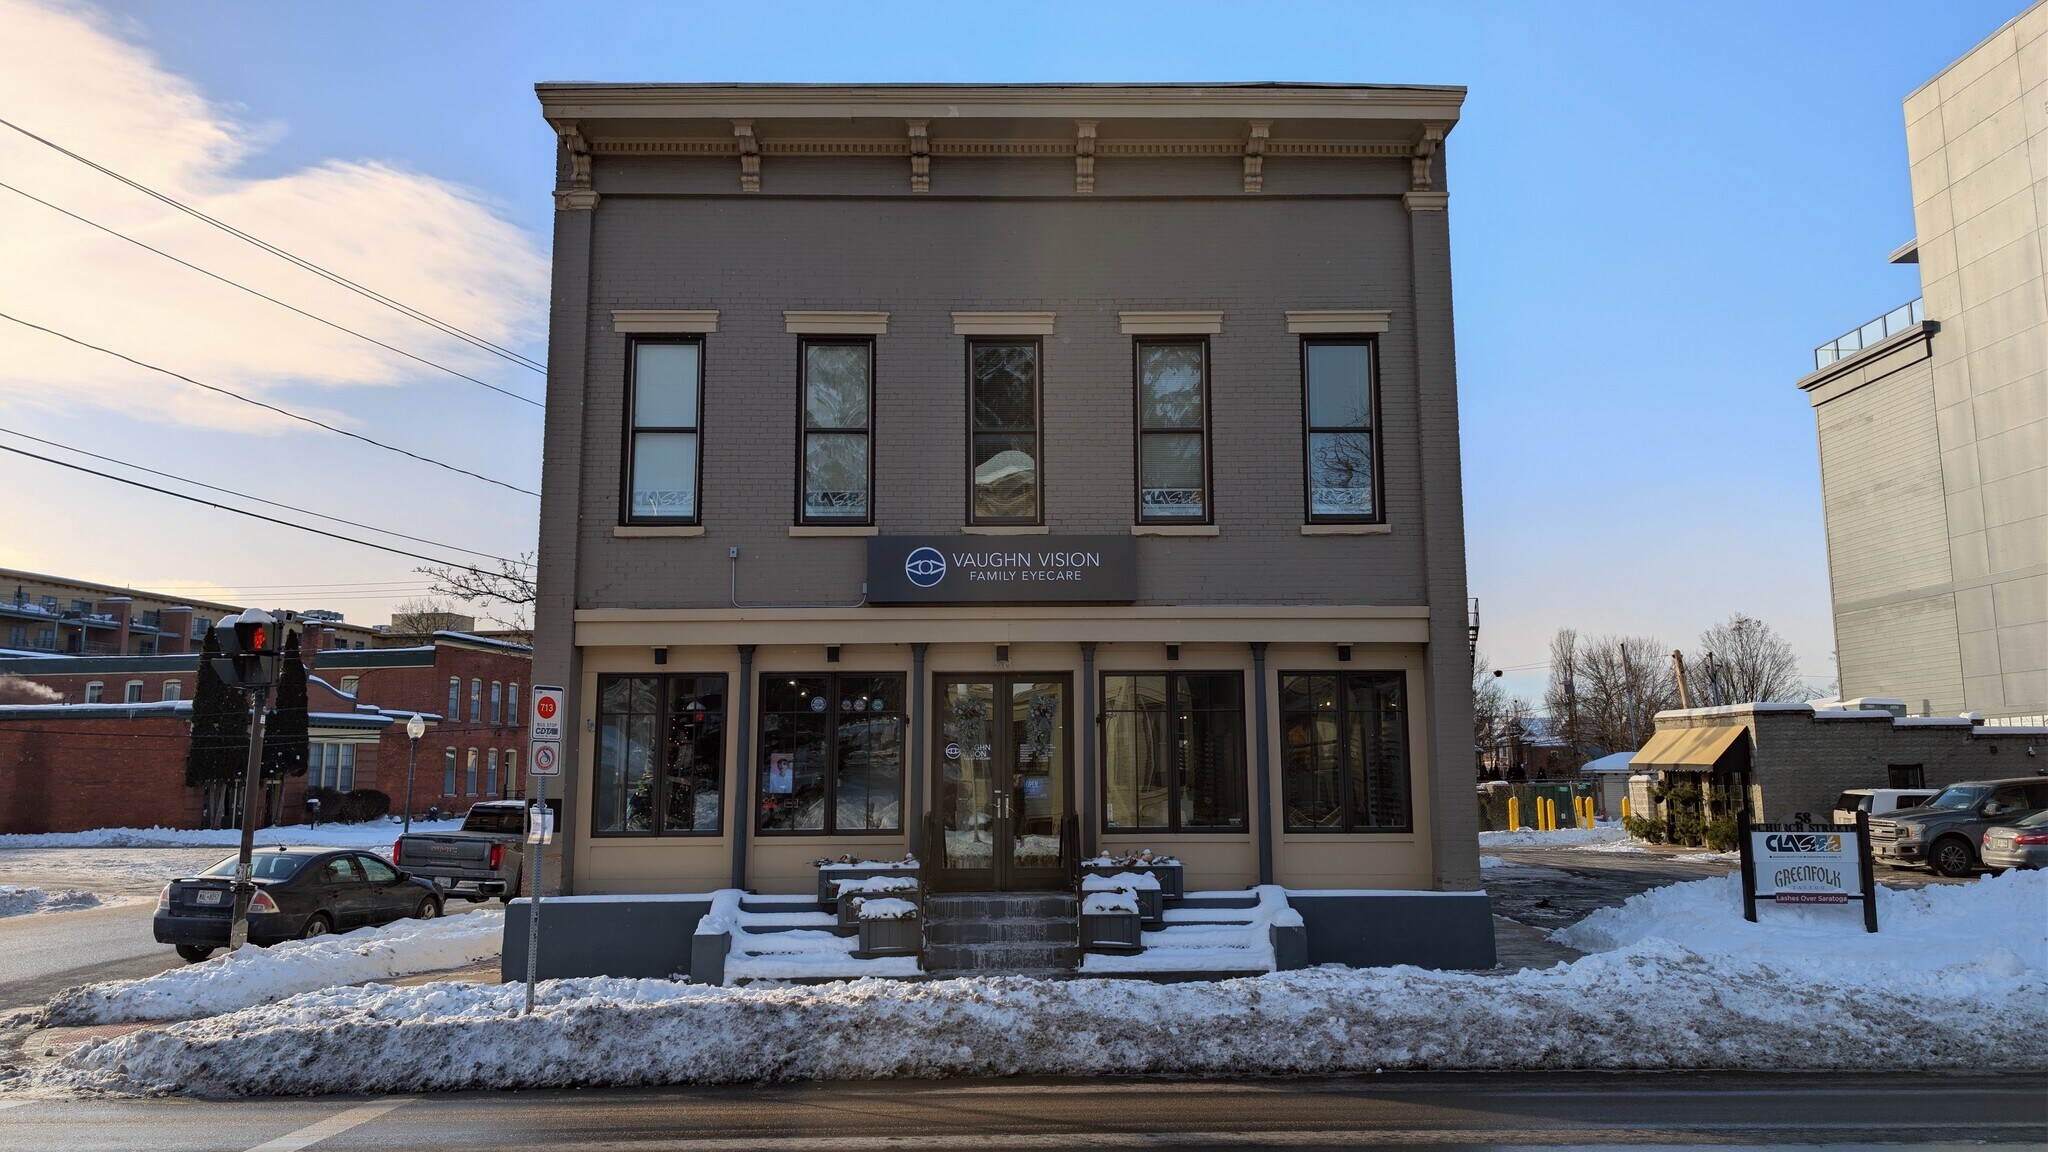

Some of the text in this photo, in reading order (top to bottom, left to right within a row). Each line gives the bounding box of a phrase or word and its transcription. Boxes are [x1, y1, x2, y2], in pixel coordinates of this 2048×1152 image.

[952, 552, 1100, 567] VAUGHN VISION
[969, 571, 1082, 581] FAMILY EYECARE
[540, 703, 554, 712] 713
[1794, 812, 1812, 825] 58
[1757, 823, 1850, 833] CHURCH STREET
[1765, 834, 1801, 852] CLA
[1774, 865, 1841, 888] GREENFOLK
[1818, 895, 1848, 903] Saratoga
